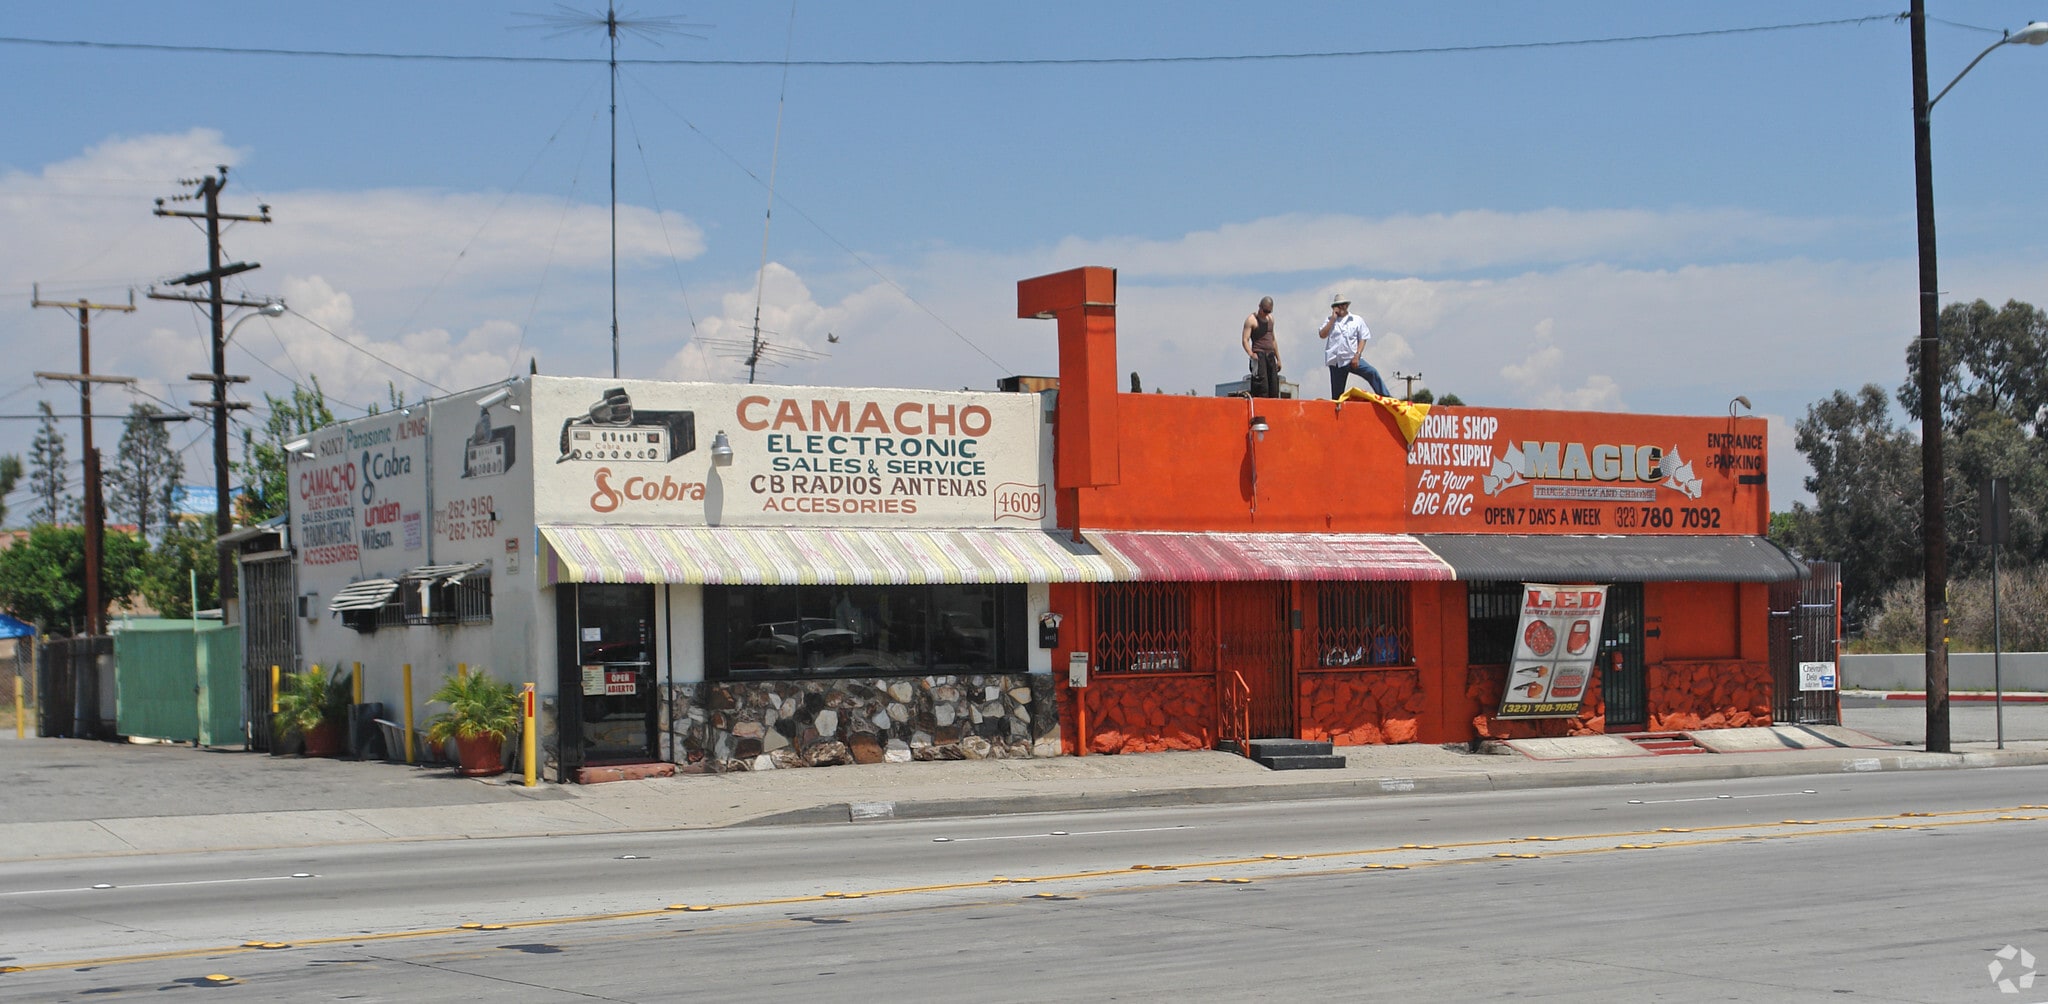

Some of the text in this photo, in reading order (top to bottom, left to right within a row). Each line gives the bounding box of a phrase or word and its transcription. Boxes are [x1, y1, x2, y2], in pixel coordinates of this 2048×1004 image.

[736, 395, 992, 437] CAMACHO
[1417, 415, 1498, 440] ROME SHOP
[346, 428, 391, 450] Panasonic
[767, 434, 978, 459] ELECTRONIC
[1707, 433, 1763, 450] ENTRANCE
[373, 447, 410, 480] Cobra
[1453, 444, 1493, 467] SUPPLY
[1522, 441, 1663, 482] MAGIC
[1714, 455, 1762, 470] PARKING
[772, 457, 986, 477] SALES & SERVICE
[301, 463, 356, 500] CAMACHO
[624, 475, 706, 501] Cobra
[750, 474, 987, 497] CB RADIOS ANTENAS
[1418, 469, 1474, 494] For Your
[1566, 487, 1597, 498] SUPPLY
[1600, 488, 1618, 498] AND
[309, 492, 348, 511] ELECTRONIC
[365, 498, 400, 527] uniden
[762, 497, 917, 514] ACCESORIES
[998, 492, 1041, 513] 4609
[1412, 492, 1474, 516] BIG RIG
[1485, 507, 1720, 529] OPEN 7 DAYS A WEEK (323) 780 7092
[304, 544, 358, 567] ACCESSORIES
[1526, 591, 1602, 608] LED
[607, 684, 634, 693] ABIERTO
[611, 673, 630, 682] OPEN
[1502, 703, 1579, 713] (323) 780-7092
